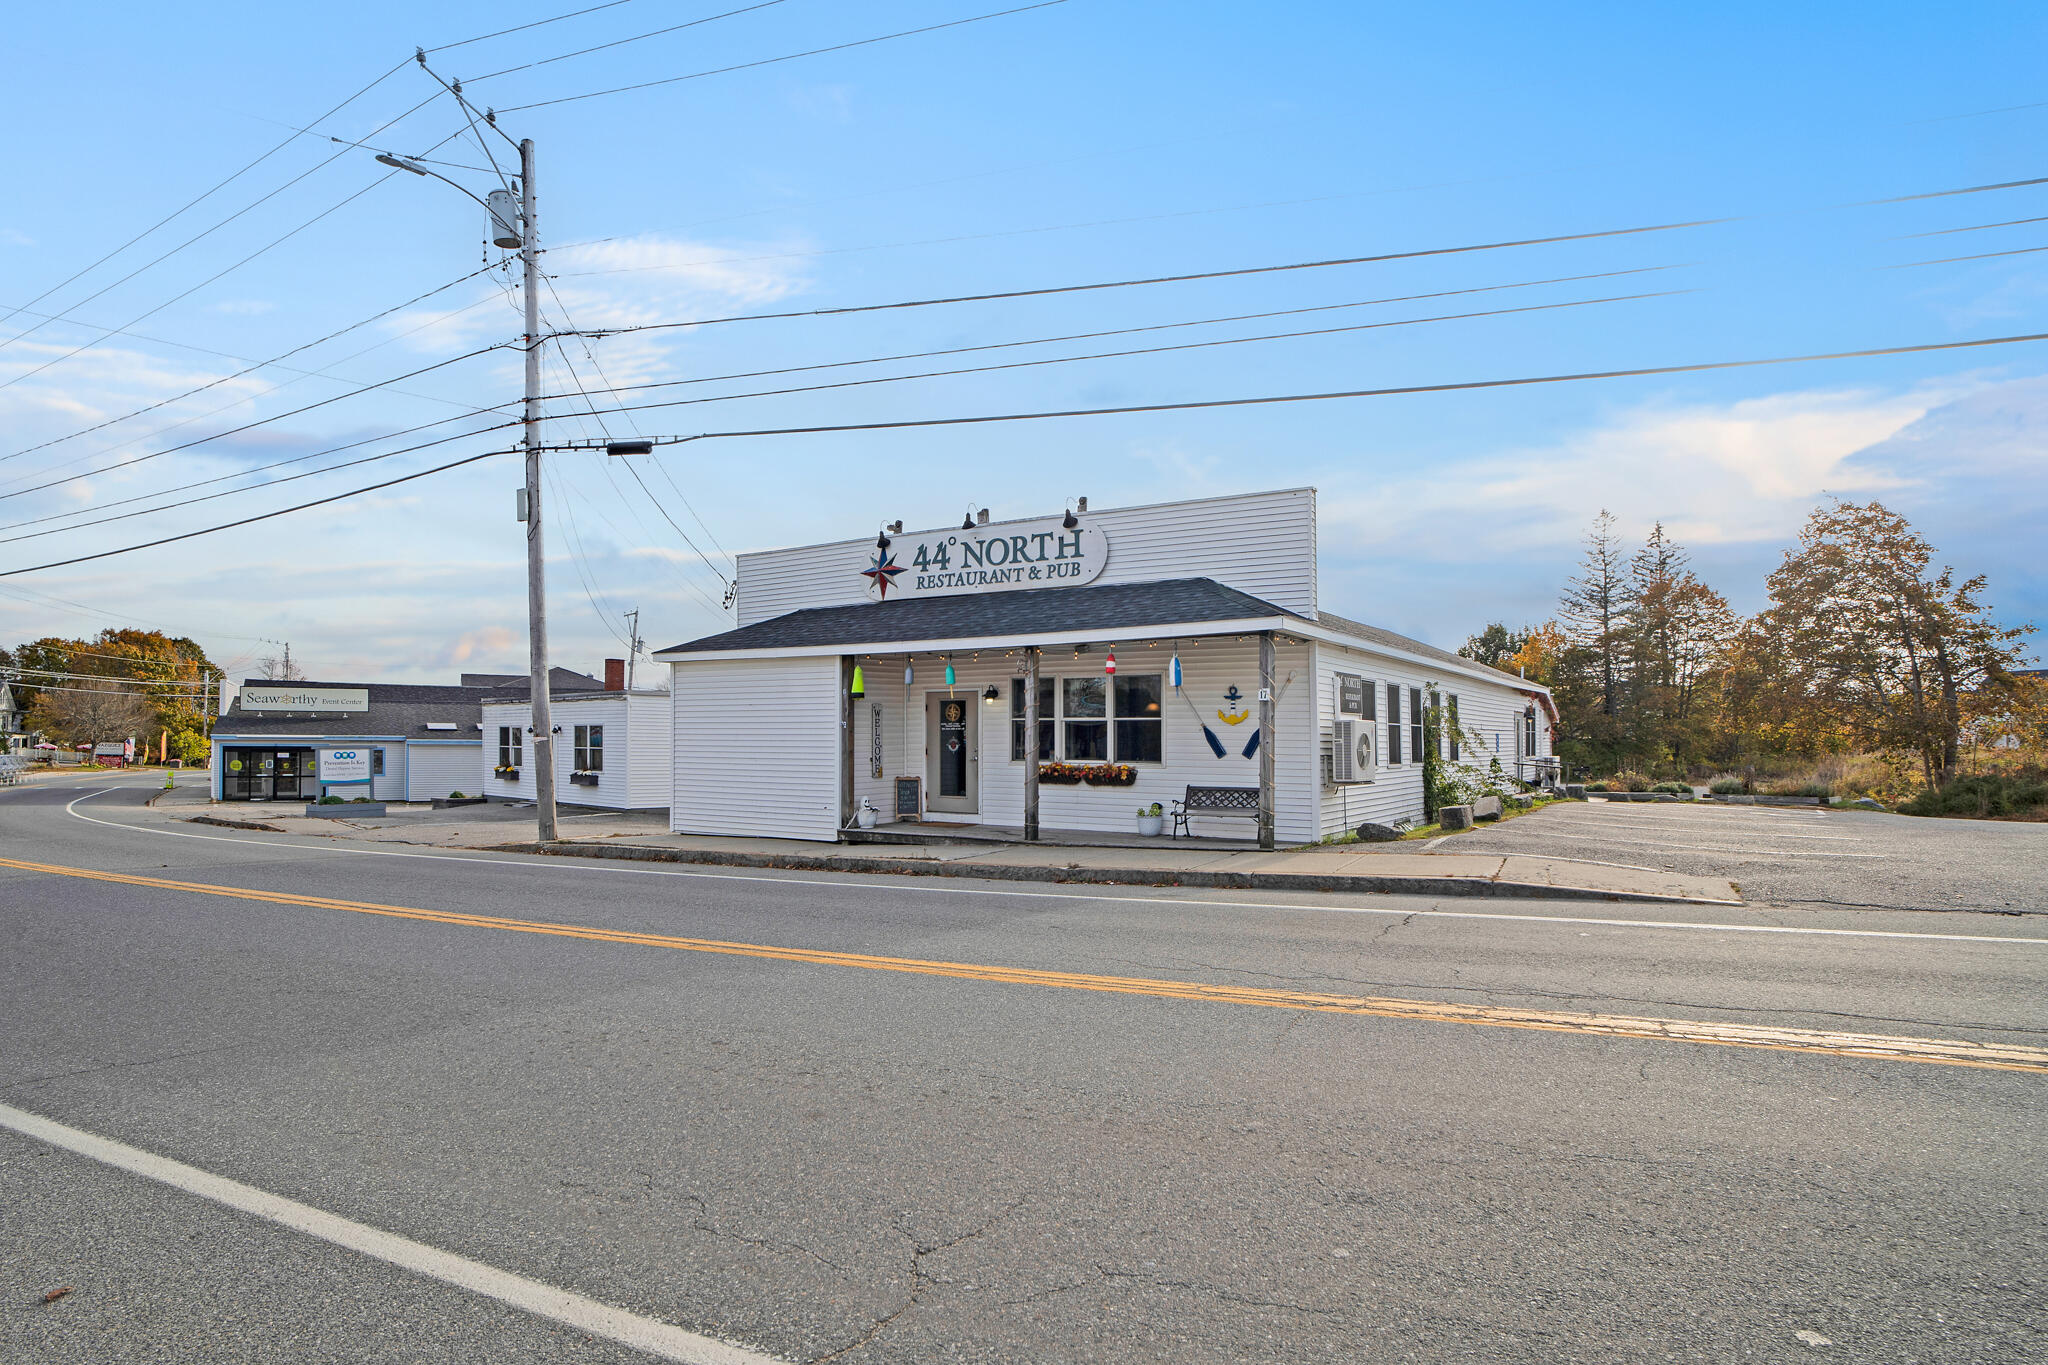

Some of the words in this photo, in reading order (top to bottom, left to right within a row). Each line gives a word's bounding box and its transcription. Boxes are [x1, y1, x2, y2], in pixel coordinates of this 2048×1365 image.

[960, 529, 1084, 569] NORTH
[916, 567, 1025, 590] RESTAURANT
[1028, 566, 1042, 580] &
[1046, 562, 1081, 579] PUB
[341, 698, 363, 706] Center
